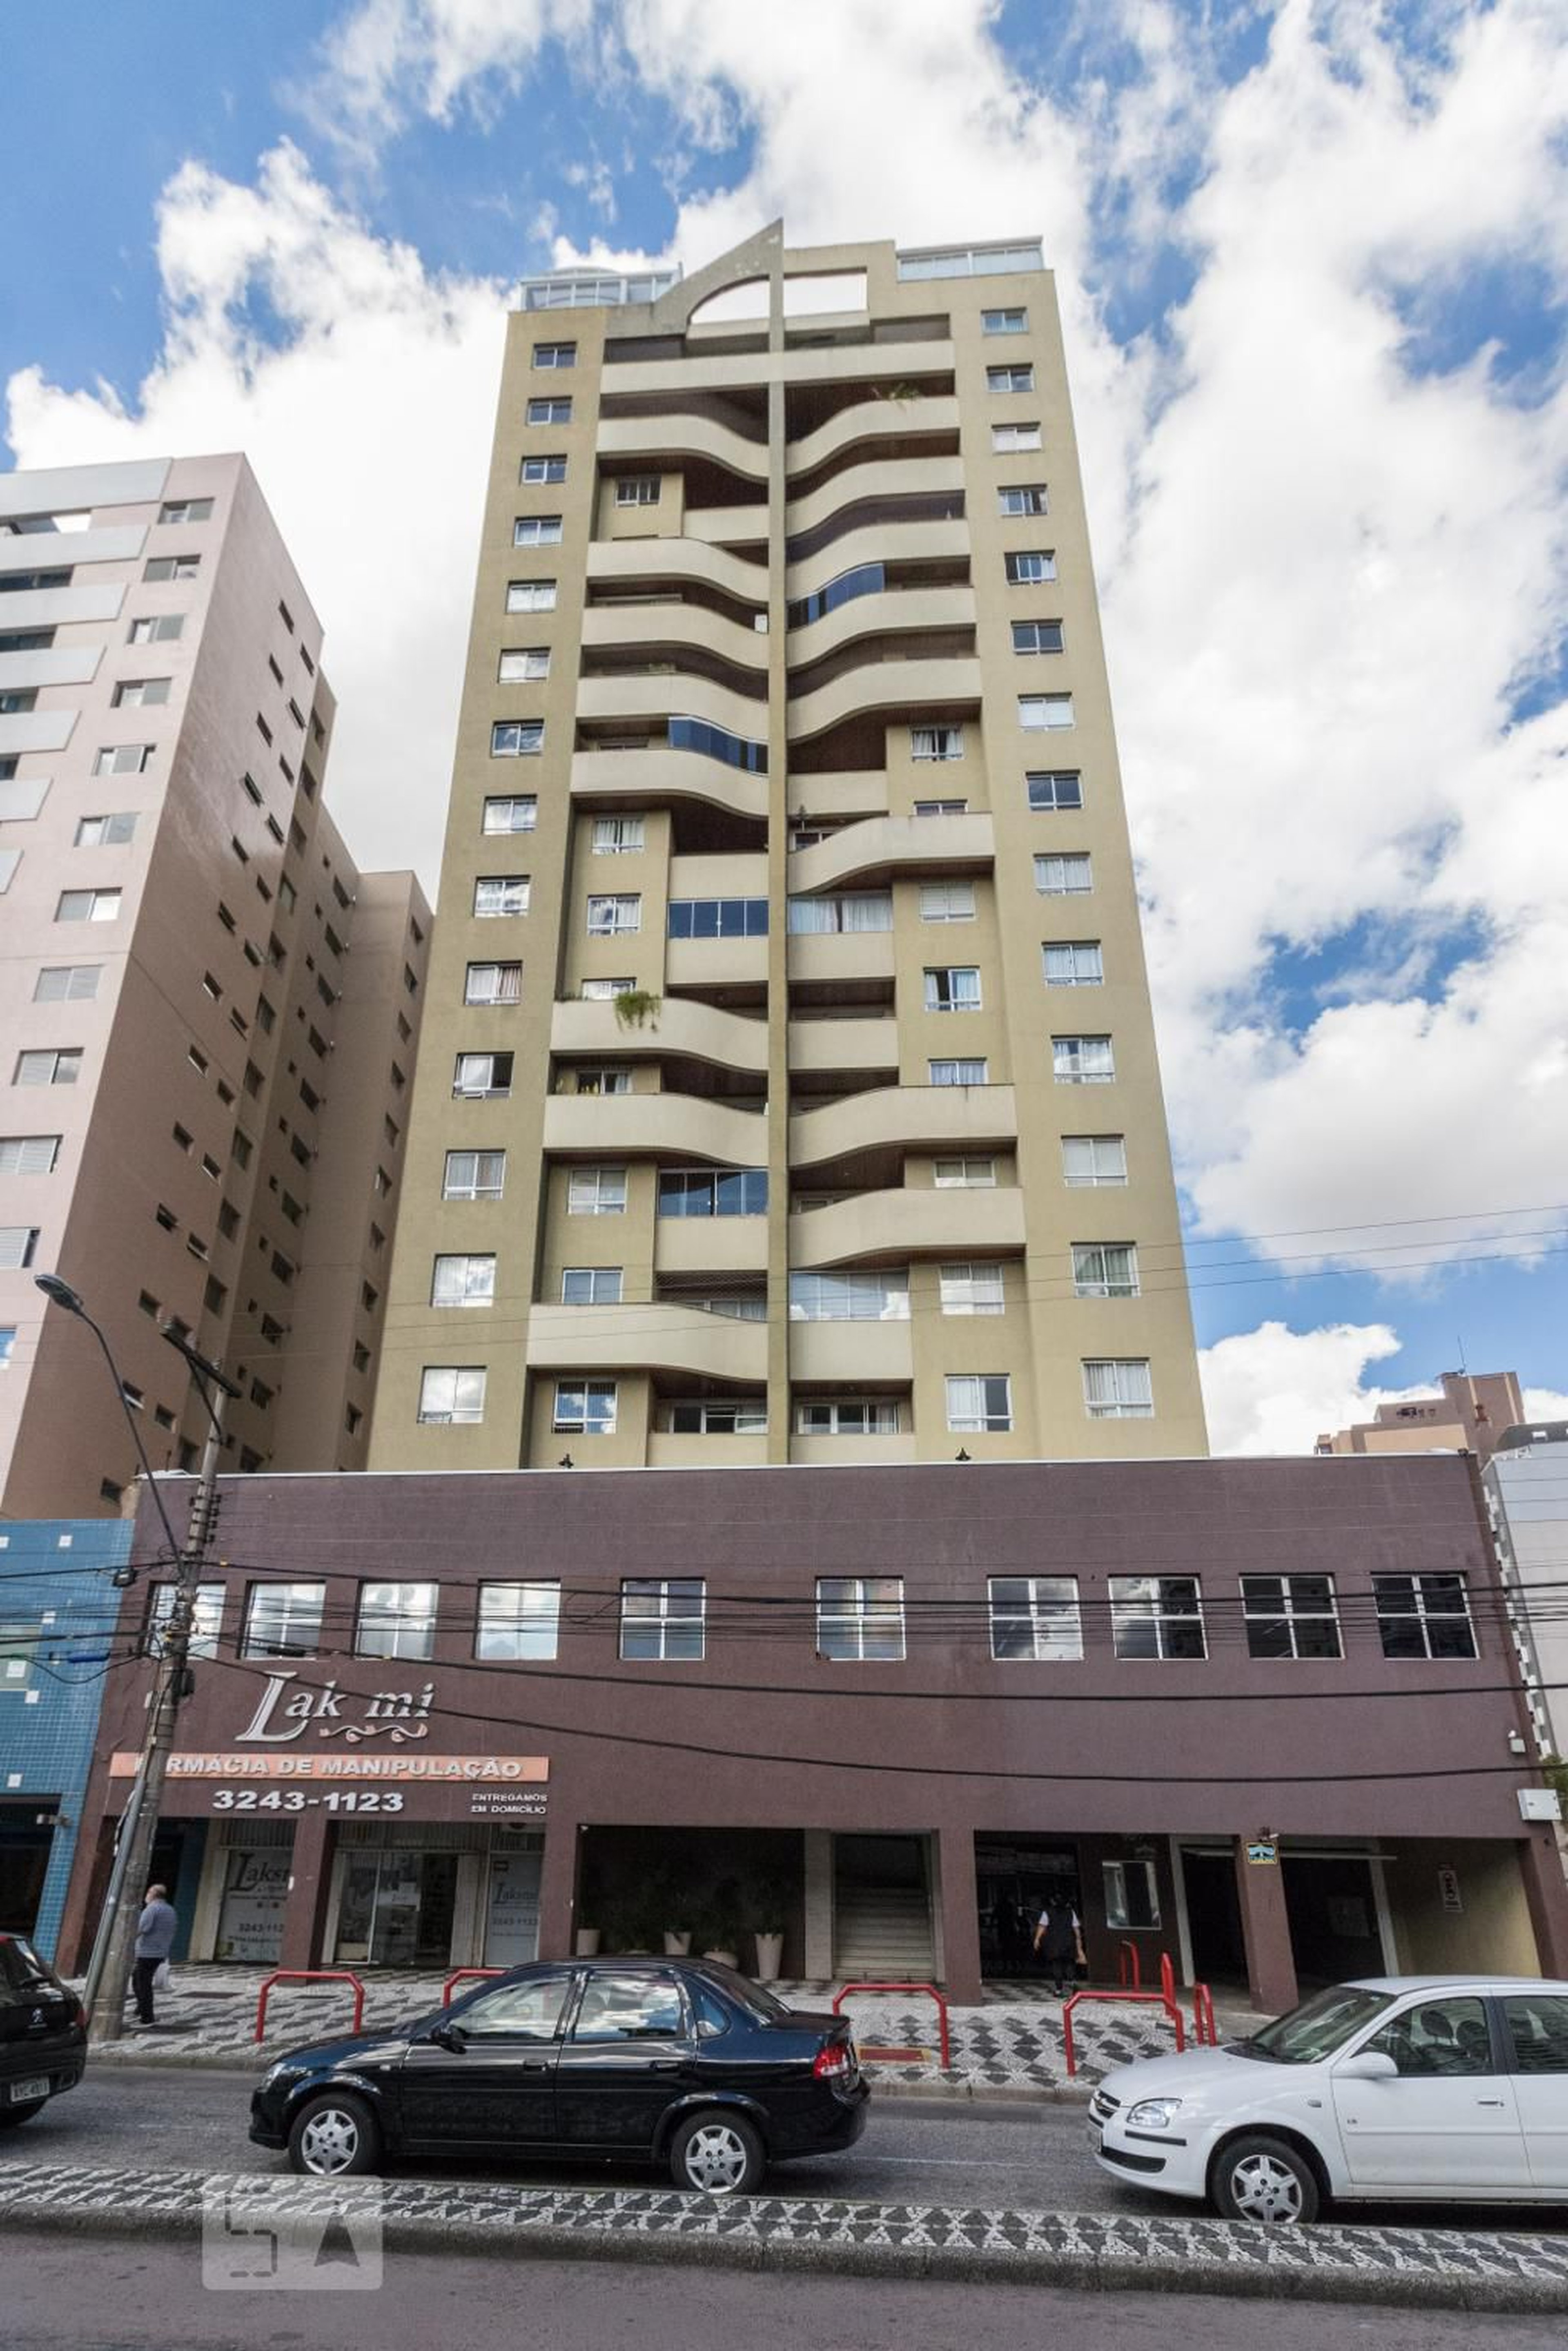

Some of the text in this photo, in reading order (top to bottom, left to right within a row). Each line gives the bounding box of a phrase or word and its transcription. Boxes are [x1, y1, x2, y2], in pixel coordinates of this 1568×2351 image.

[278, 1759, 313, 1775] DE
[320, 1758, 522, 1780] MANIPULAÇÃO
[213, 1790, 403, 1812] 3243-1123
[472, 1793, 548, 1802] ENTREGAMOS
